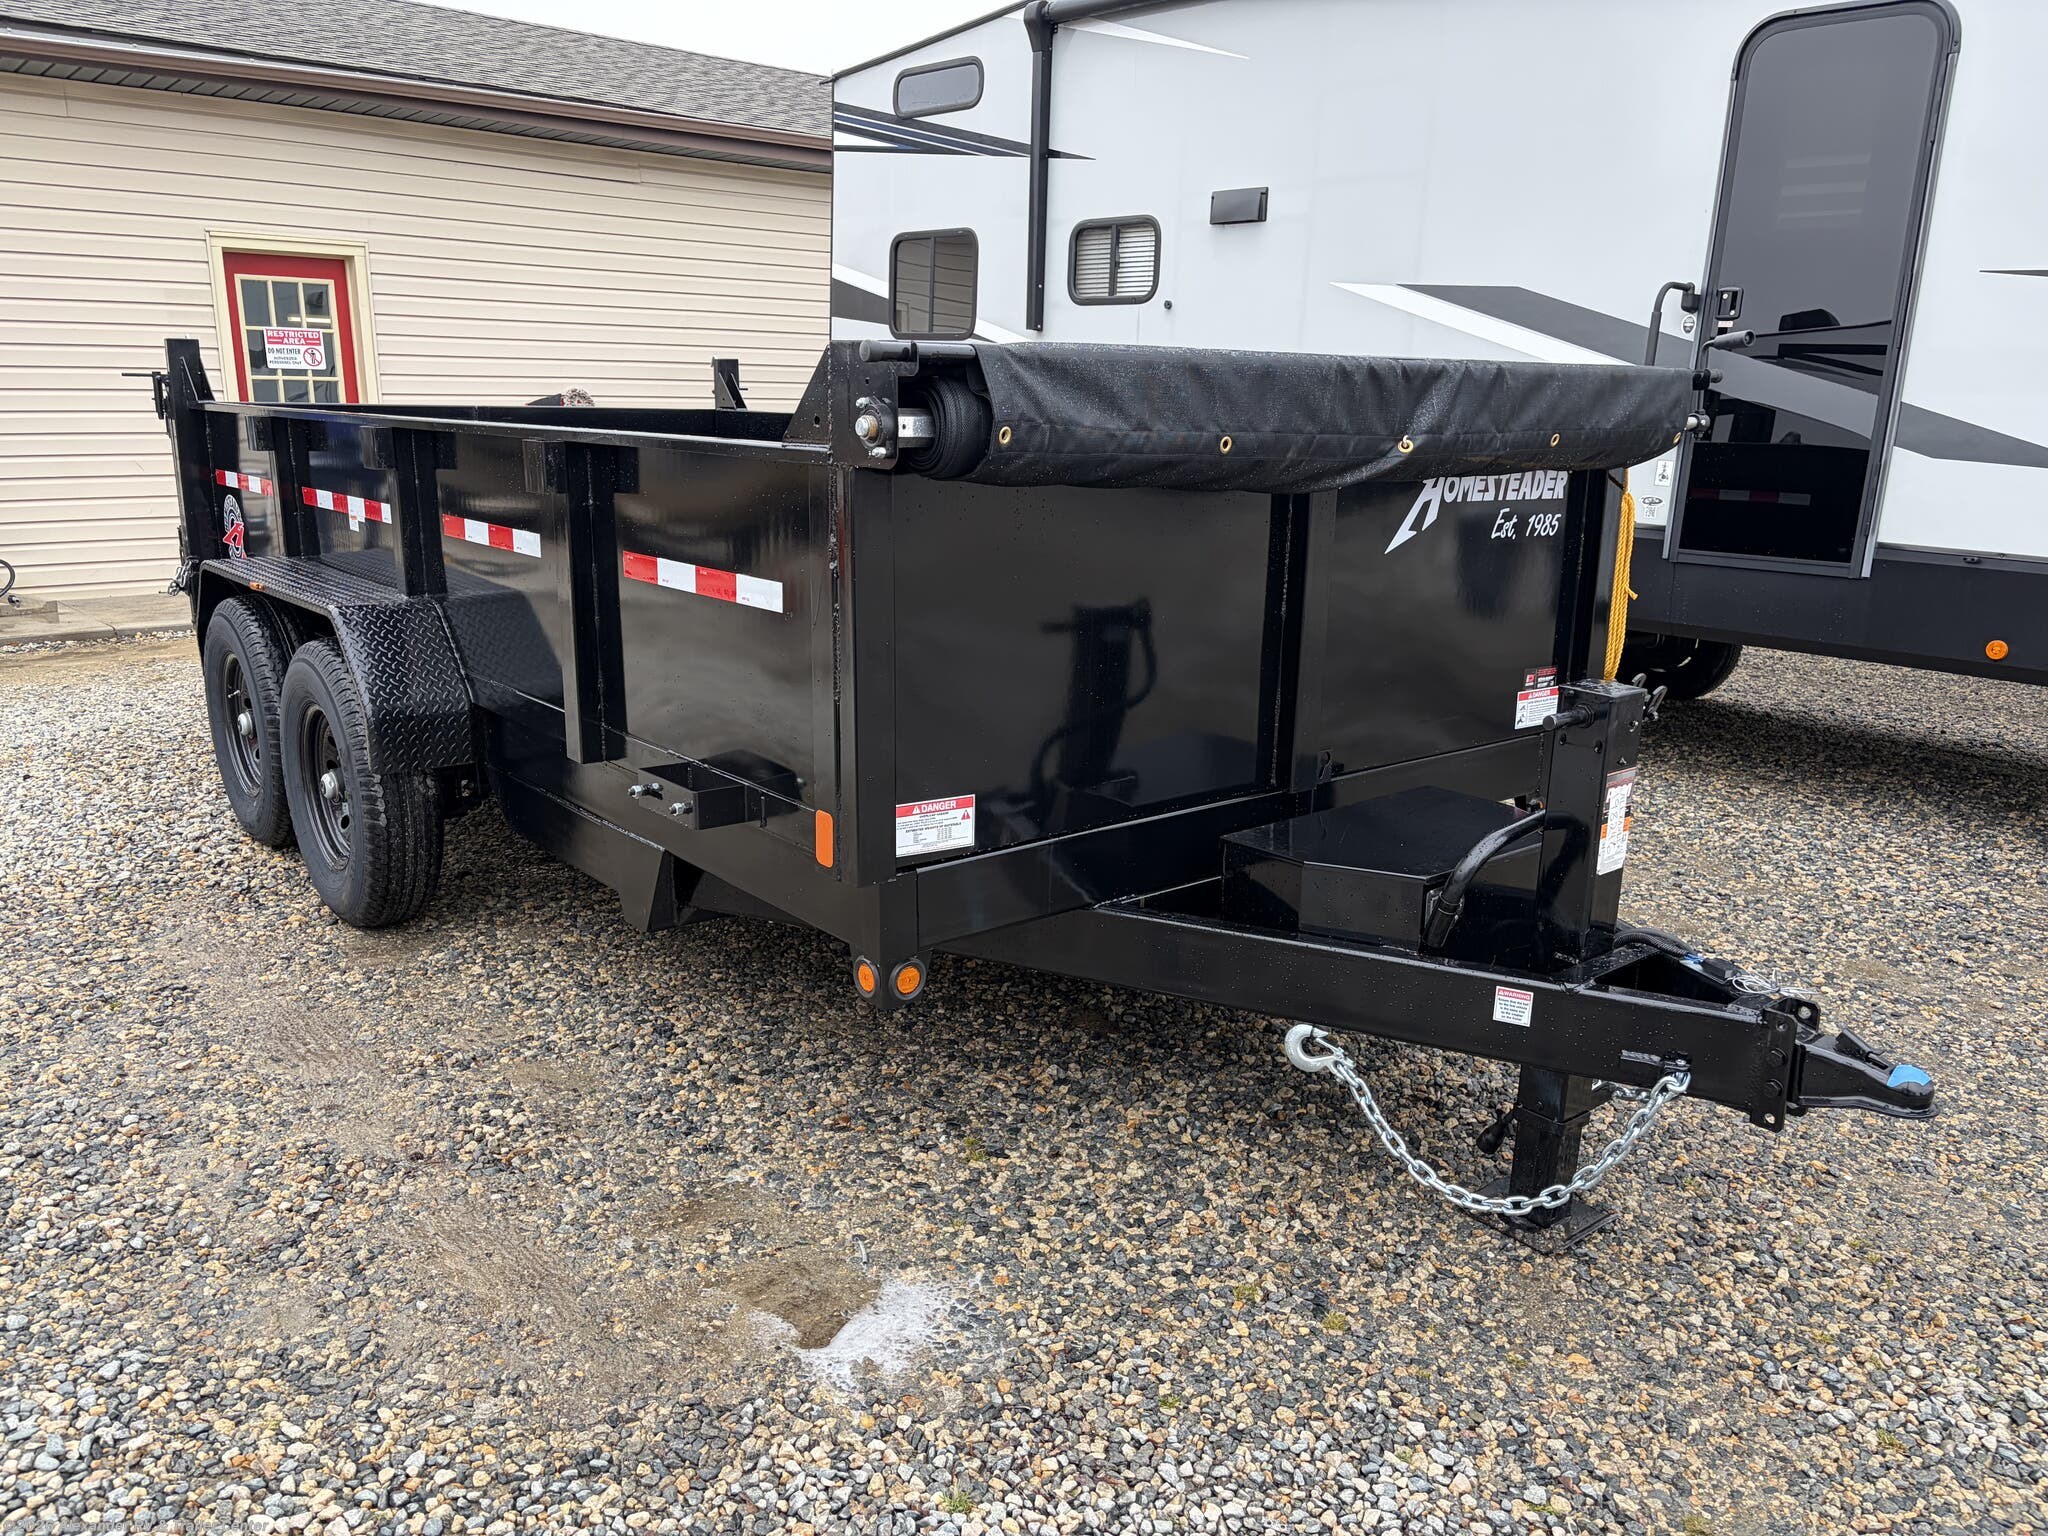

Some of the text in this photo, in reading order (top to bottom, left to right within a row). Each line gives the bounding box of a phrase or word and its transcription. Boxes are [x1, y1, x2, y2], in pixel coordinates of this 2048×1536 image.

[267, 330, 319, 338] RESTRICTED
[283, 337, 306, 345] AREA
[1384, 470, 1569, 555] HOMESTEADER
[1525, 513, 1562, 538] 1985
[921, 800, 957, 813] DANGER
[1503, 991, 1530, 1000] WARNING
